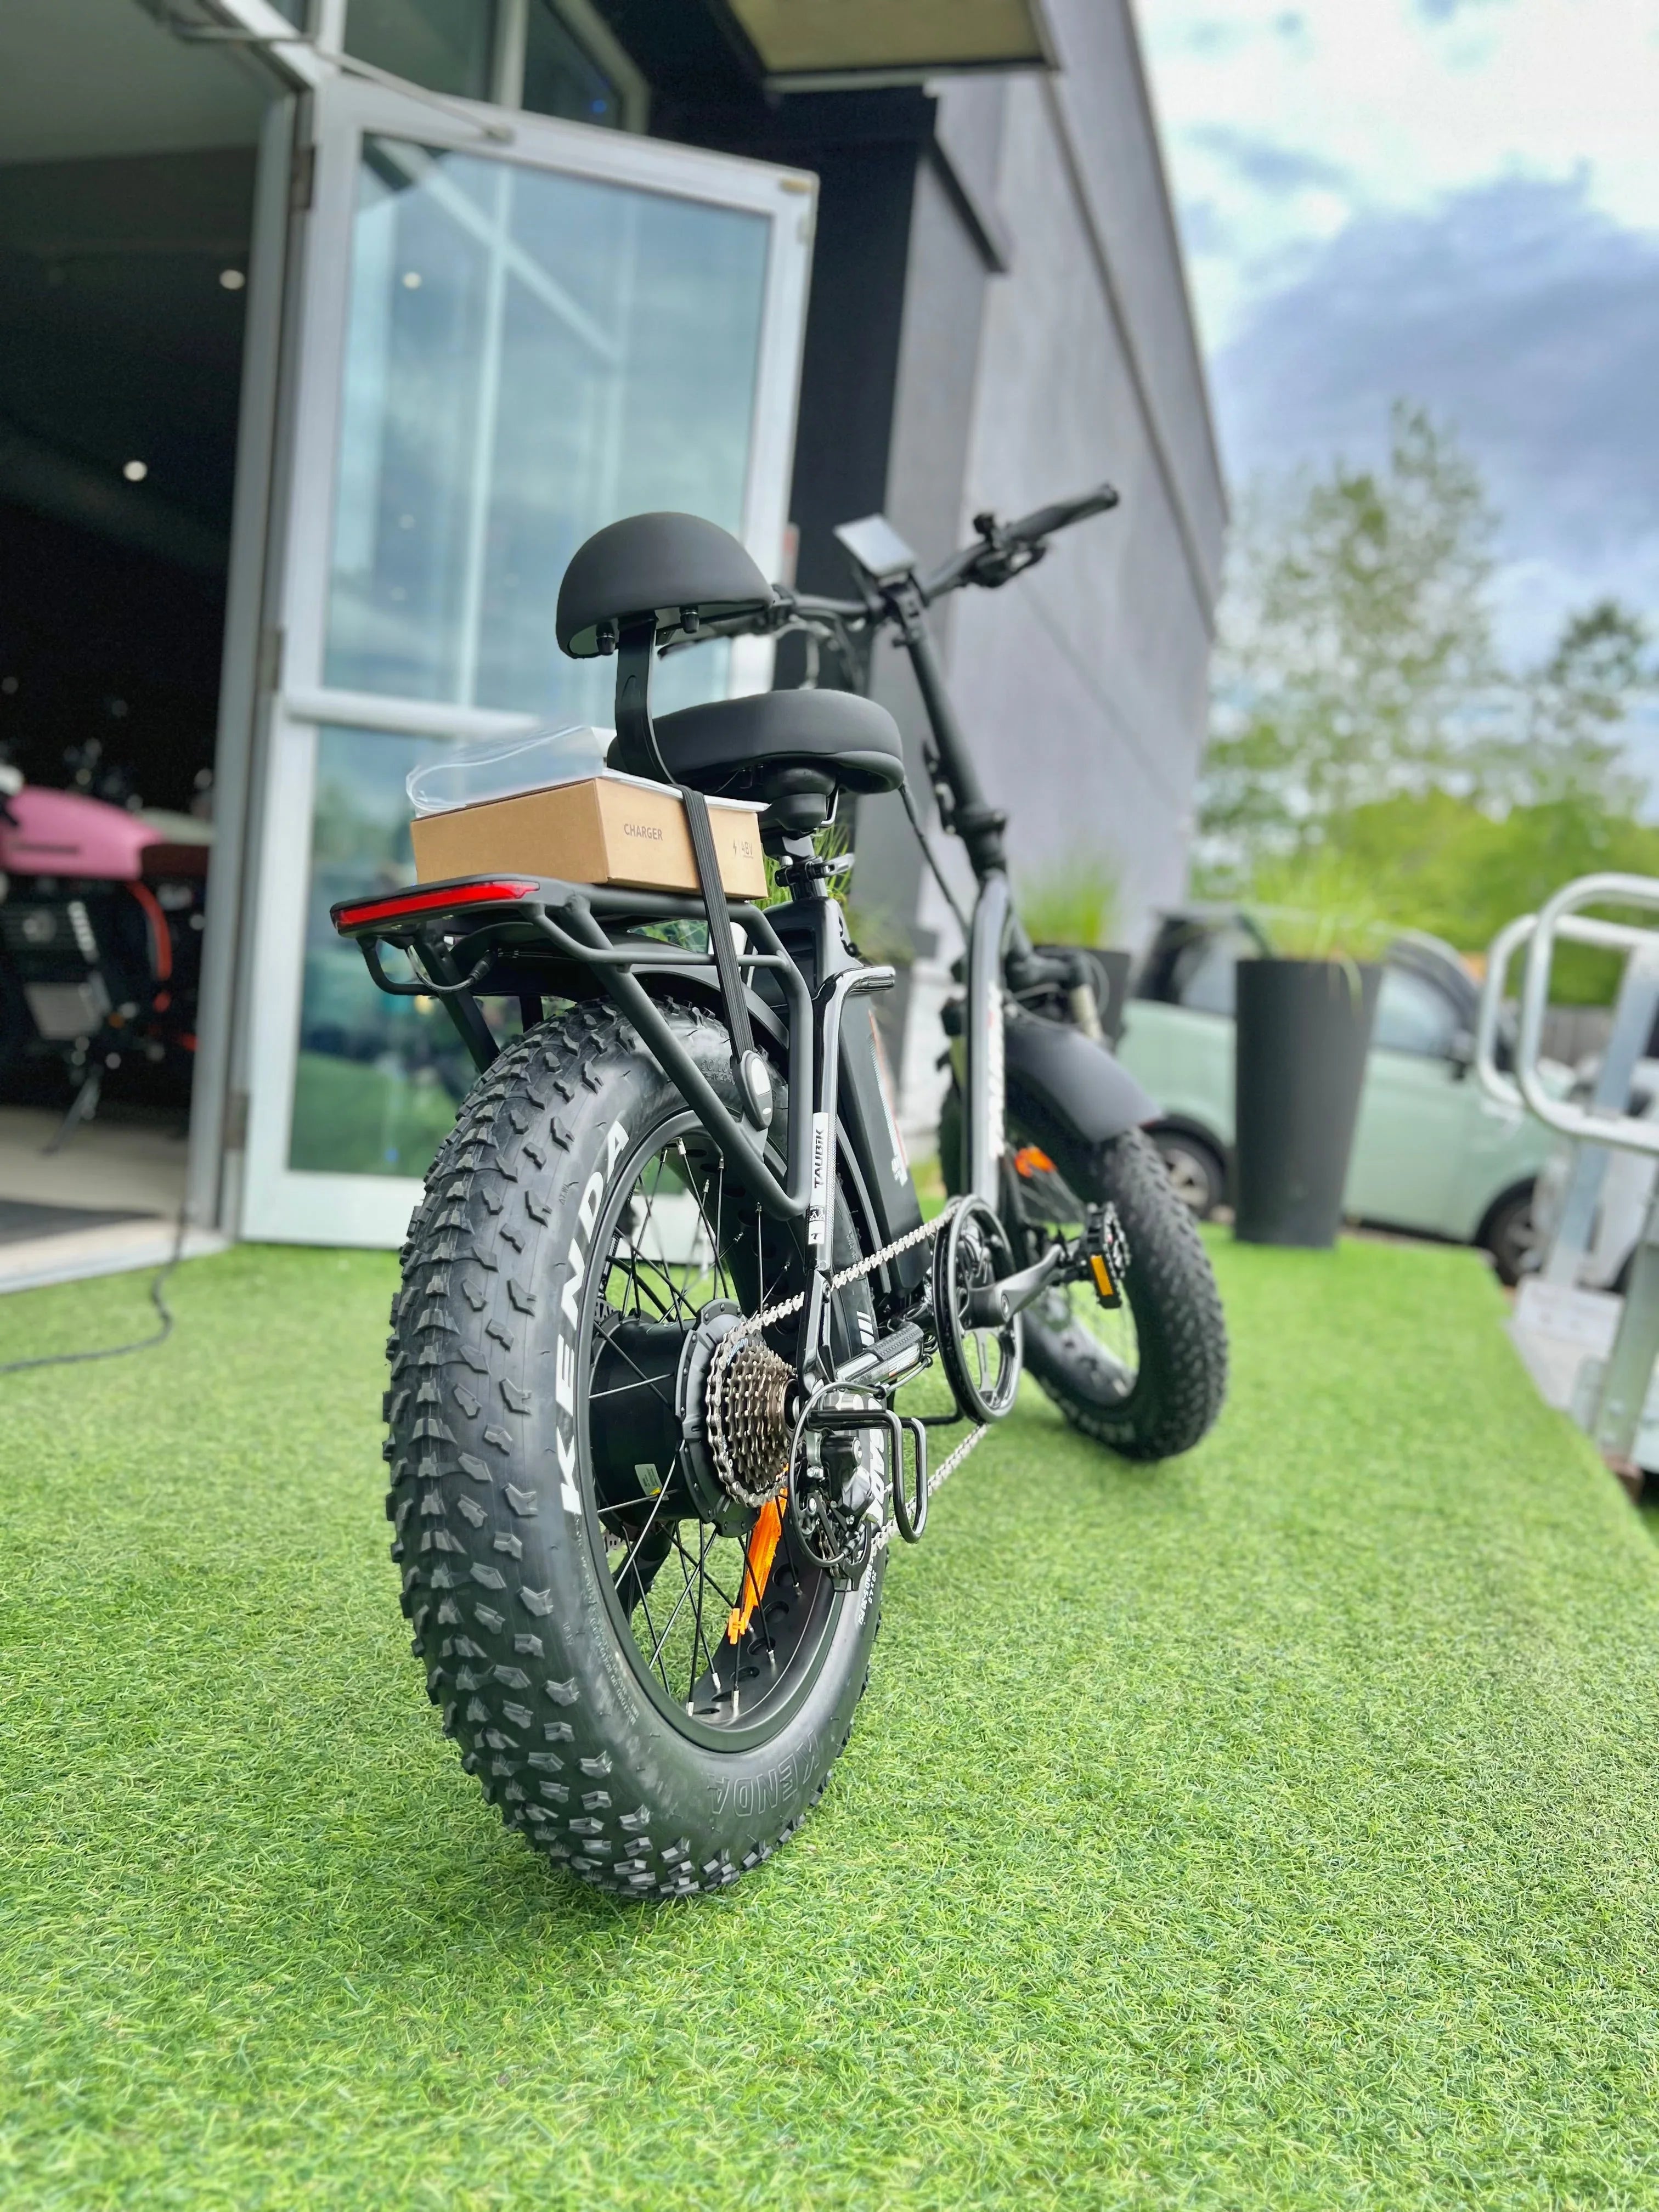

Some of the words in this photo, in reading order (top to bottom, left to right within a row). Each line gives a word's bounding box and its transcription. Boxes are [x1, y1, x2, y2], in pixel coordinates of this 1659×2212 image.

[624, 823, 663, 841] CHARGER
[556, 1120, 629, 1515] KENDA
[871, 1569, 877, 1583] 20
[707, 1730, 820, 1817] KENDA
